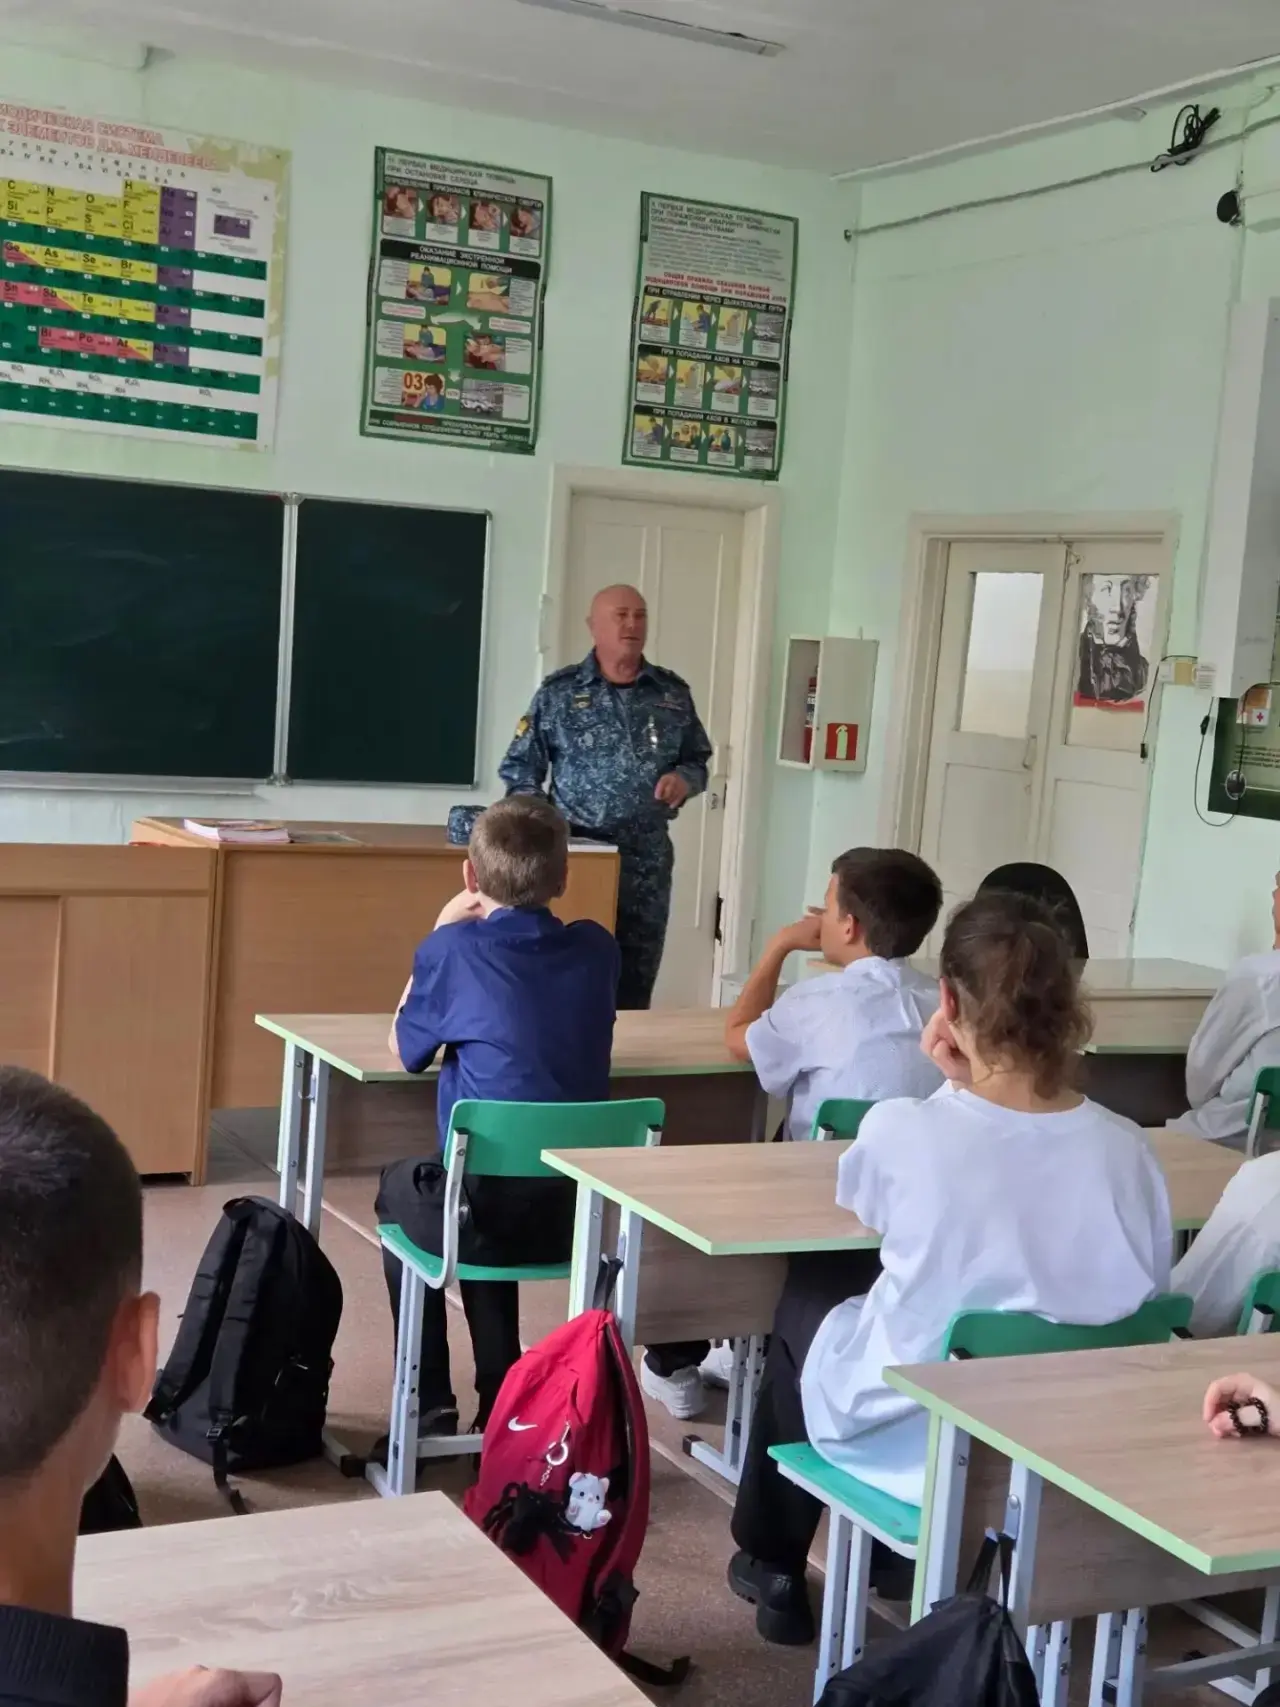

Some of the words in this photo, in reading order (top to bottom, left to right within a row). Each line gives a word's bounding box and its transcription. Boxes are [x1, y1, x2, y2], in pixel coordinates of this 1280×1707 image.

[8, 180, 16, 189] C
[47, 187, 55, 197] N
[86, 194, 95, 203] O
[125, 181, 132, 189] H
[8, 201, 18, 211] Si
[85, 214, 92, 223] S
[123, 221, 133, 231] Cl
[5, 242, 20, 252] Ge
[44, 248, 59, 257] As
[83, 254, 97, 264] Se
[121, 260, 132, 269] Br
[404, 372, 423, 390] 03
